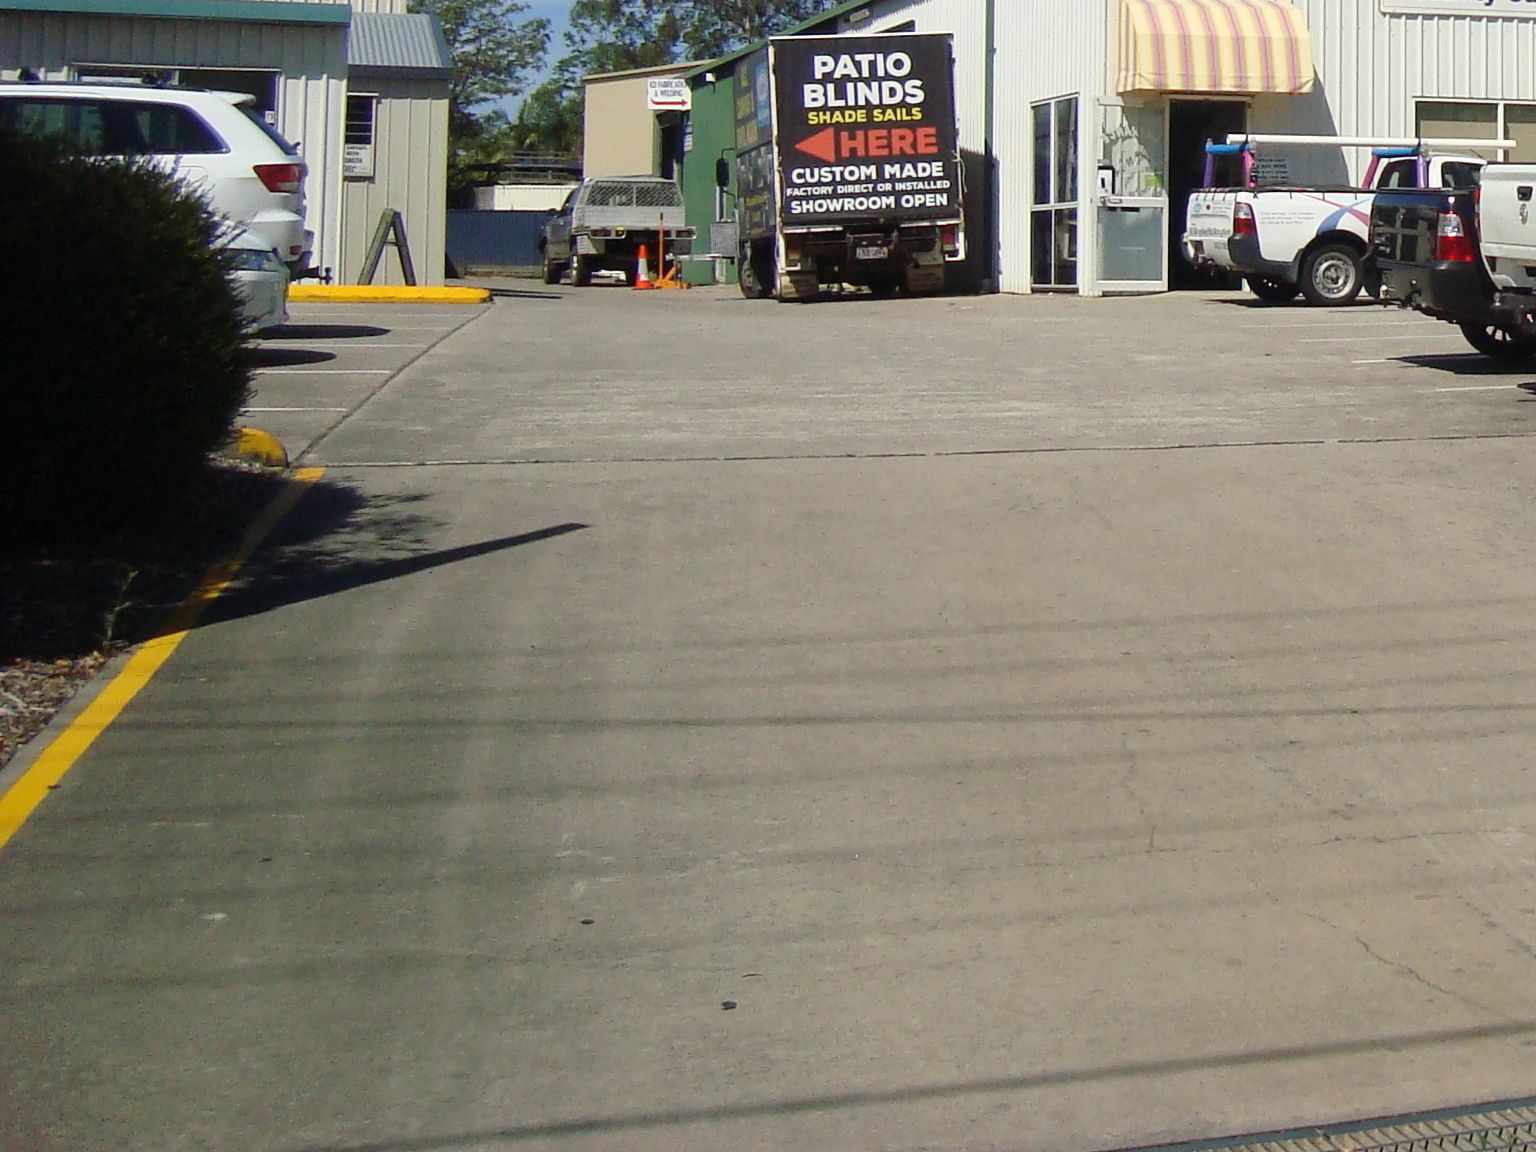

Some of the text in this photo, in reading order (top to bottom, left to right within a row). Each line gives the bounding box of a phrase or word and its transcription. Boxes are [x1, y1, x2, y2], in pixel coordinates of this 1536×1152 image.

[813, 52, 912, 80] PATIO
[803, 79, 925, 108] BLINDS
[807, 107, 922, 125] SHADE SAILS
[840, 127, 938, 158] HERE
[791, 162, 944, 184] CUSTOM MADE
[787, 180, 950, 197] FACTORY DIRECT OR INSTALLED
[791, 193, 947, 214] SHOWROOM OPEN
